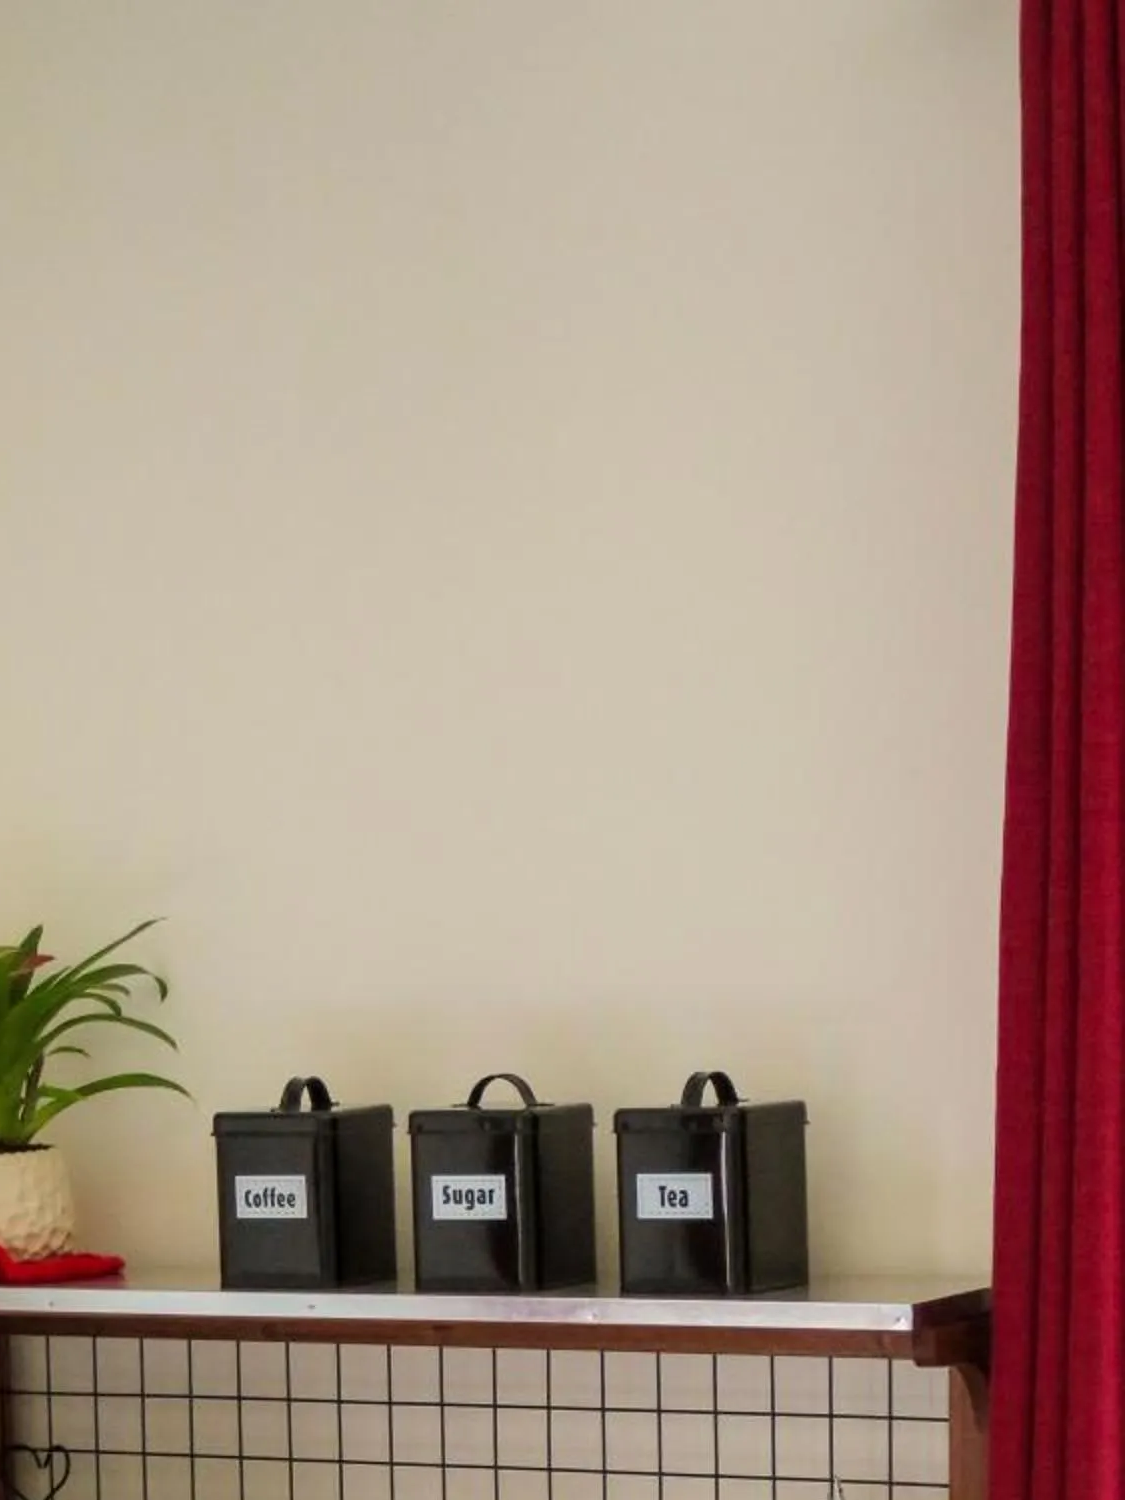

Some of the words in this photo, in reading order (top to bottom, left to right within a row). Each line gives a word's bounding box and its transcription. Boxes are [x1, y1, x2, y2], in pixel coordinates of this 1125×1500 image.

[244, 1186, 296, 1208] Coffee
[442, 1185, 495, 1211] Sugar
[658, 1185, 689, 1208] Tea
